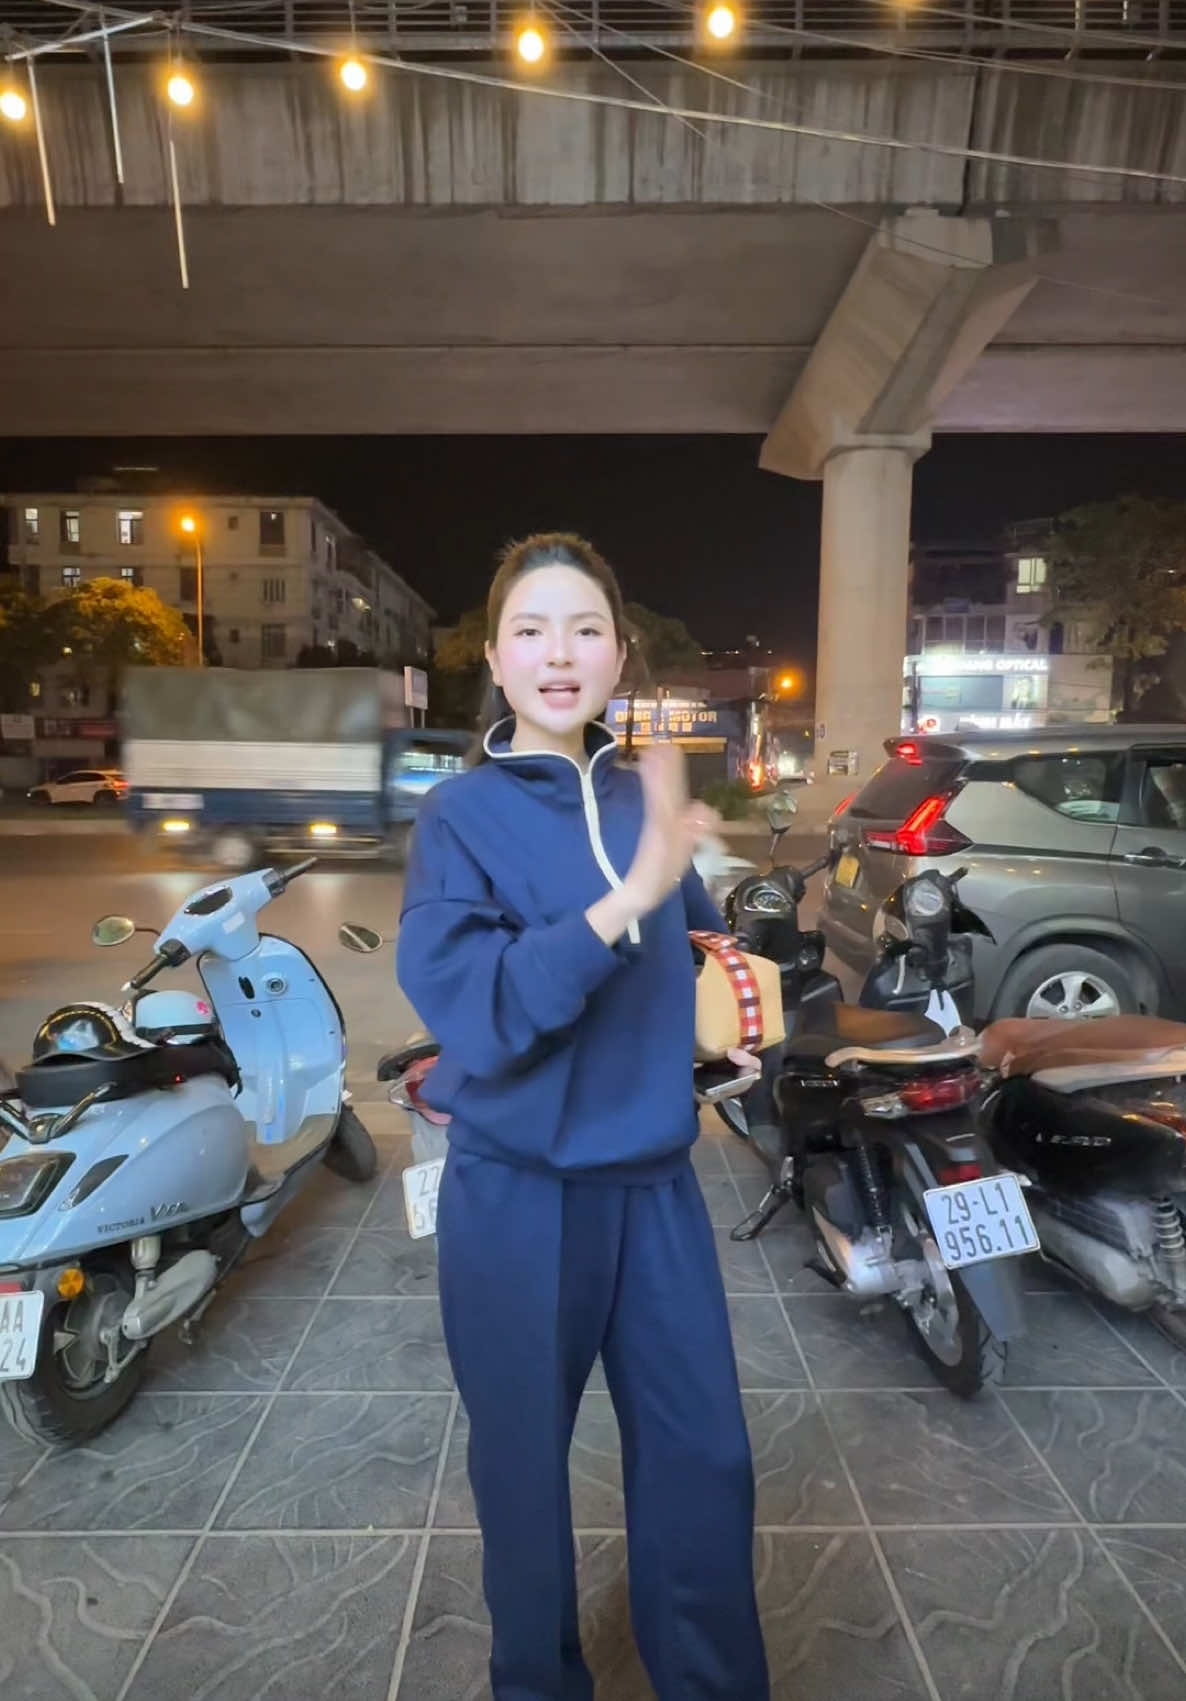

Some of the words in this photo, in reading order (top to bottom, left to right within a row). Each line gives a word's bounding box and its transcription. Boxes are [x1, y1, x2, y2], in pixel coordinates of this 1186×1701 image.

[996, 659, 1048, 671] OPTICAL
[941, 1182, 1010, 1225] 29-L1
[943, 1214, 1030, 1262] 956.11
